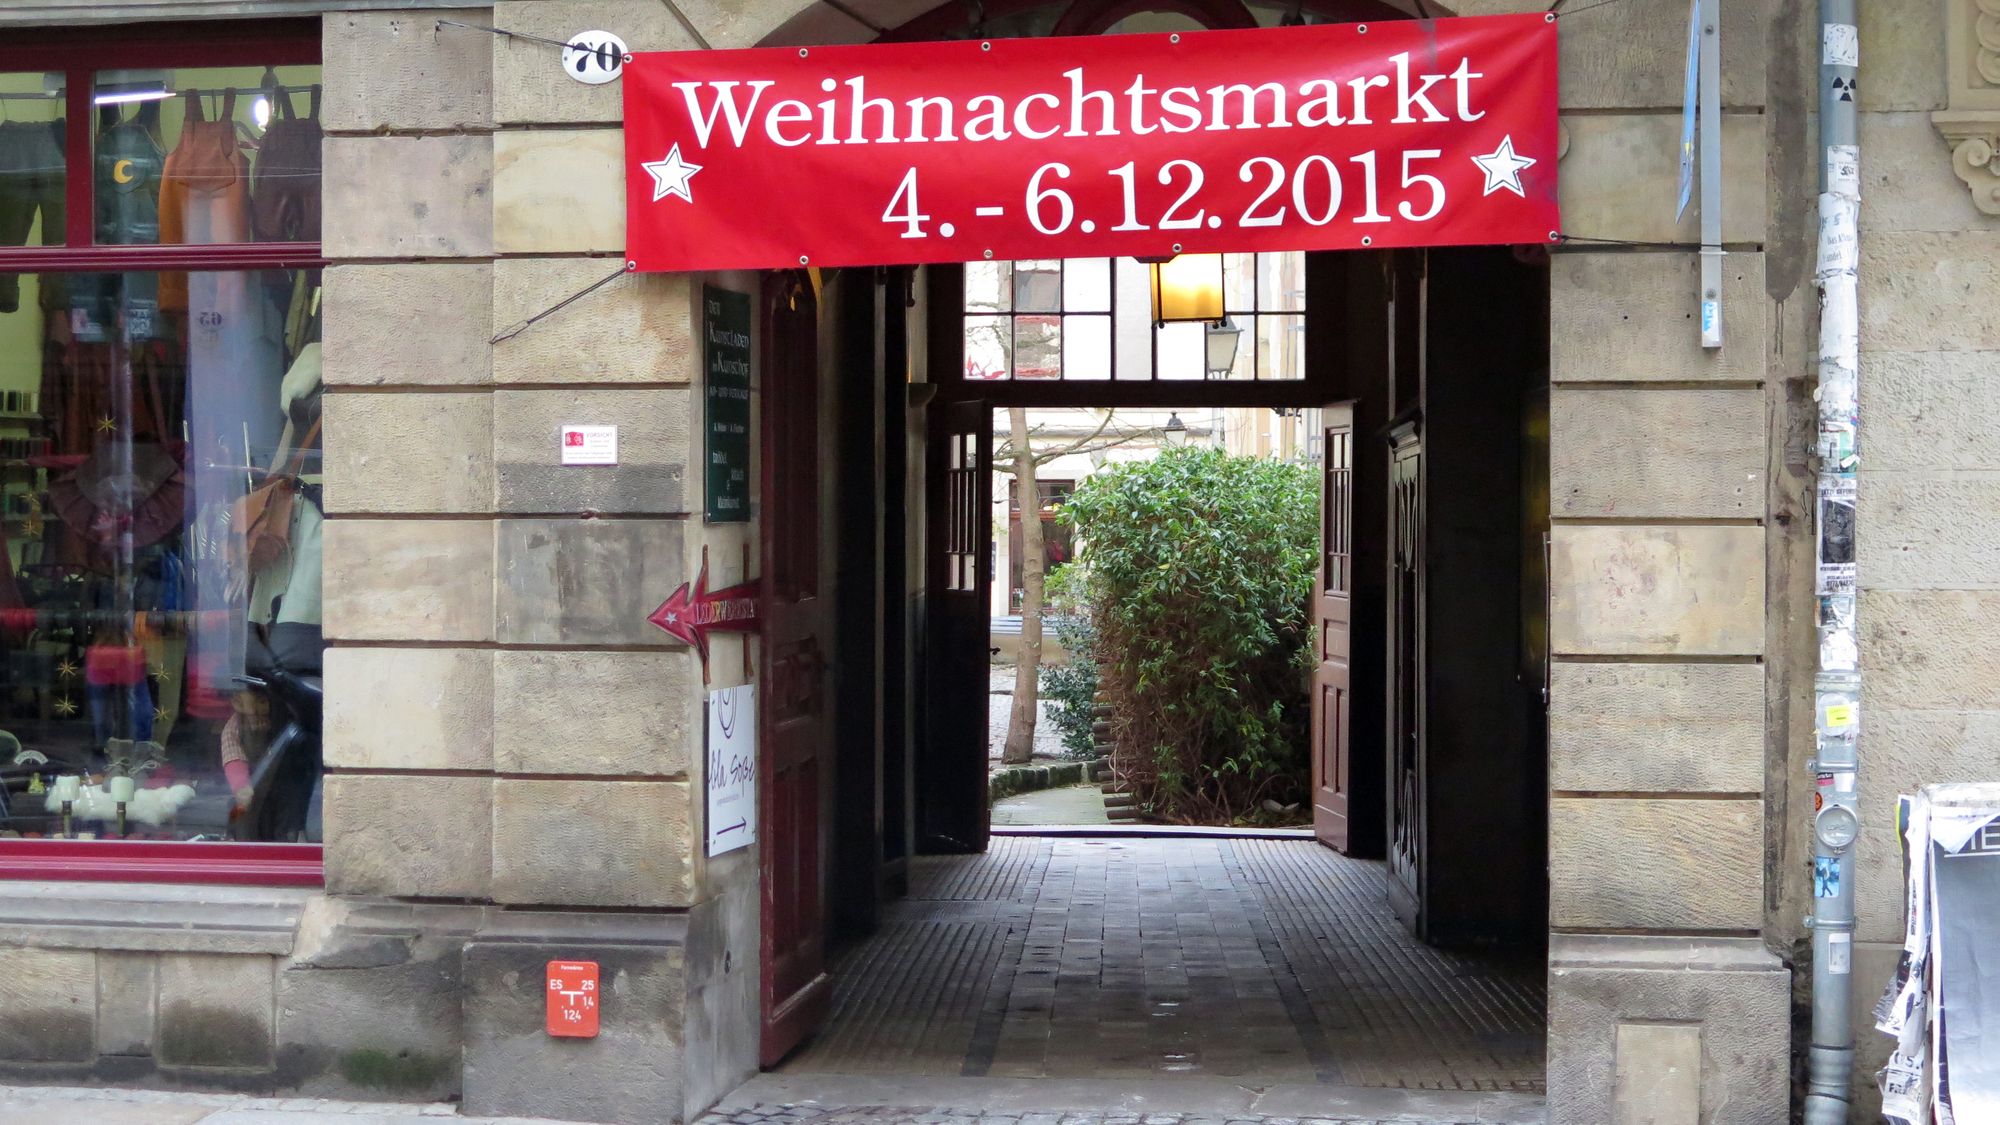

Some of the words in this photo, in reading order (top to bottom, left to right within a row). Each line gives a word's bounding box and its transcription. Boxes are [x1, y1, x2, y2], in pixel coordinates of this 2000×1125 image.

[571, 40, 622, 72] 70
[671, 51, 1486, 149] Weihnachtsmarkt
[881, 167, 955, 239] 4.
[1025, 149, 1446, 236] 6.12.2015
[550, 979, 563, 990] ES
[581, 980, 594, 991] 25
